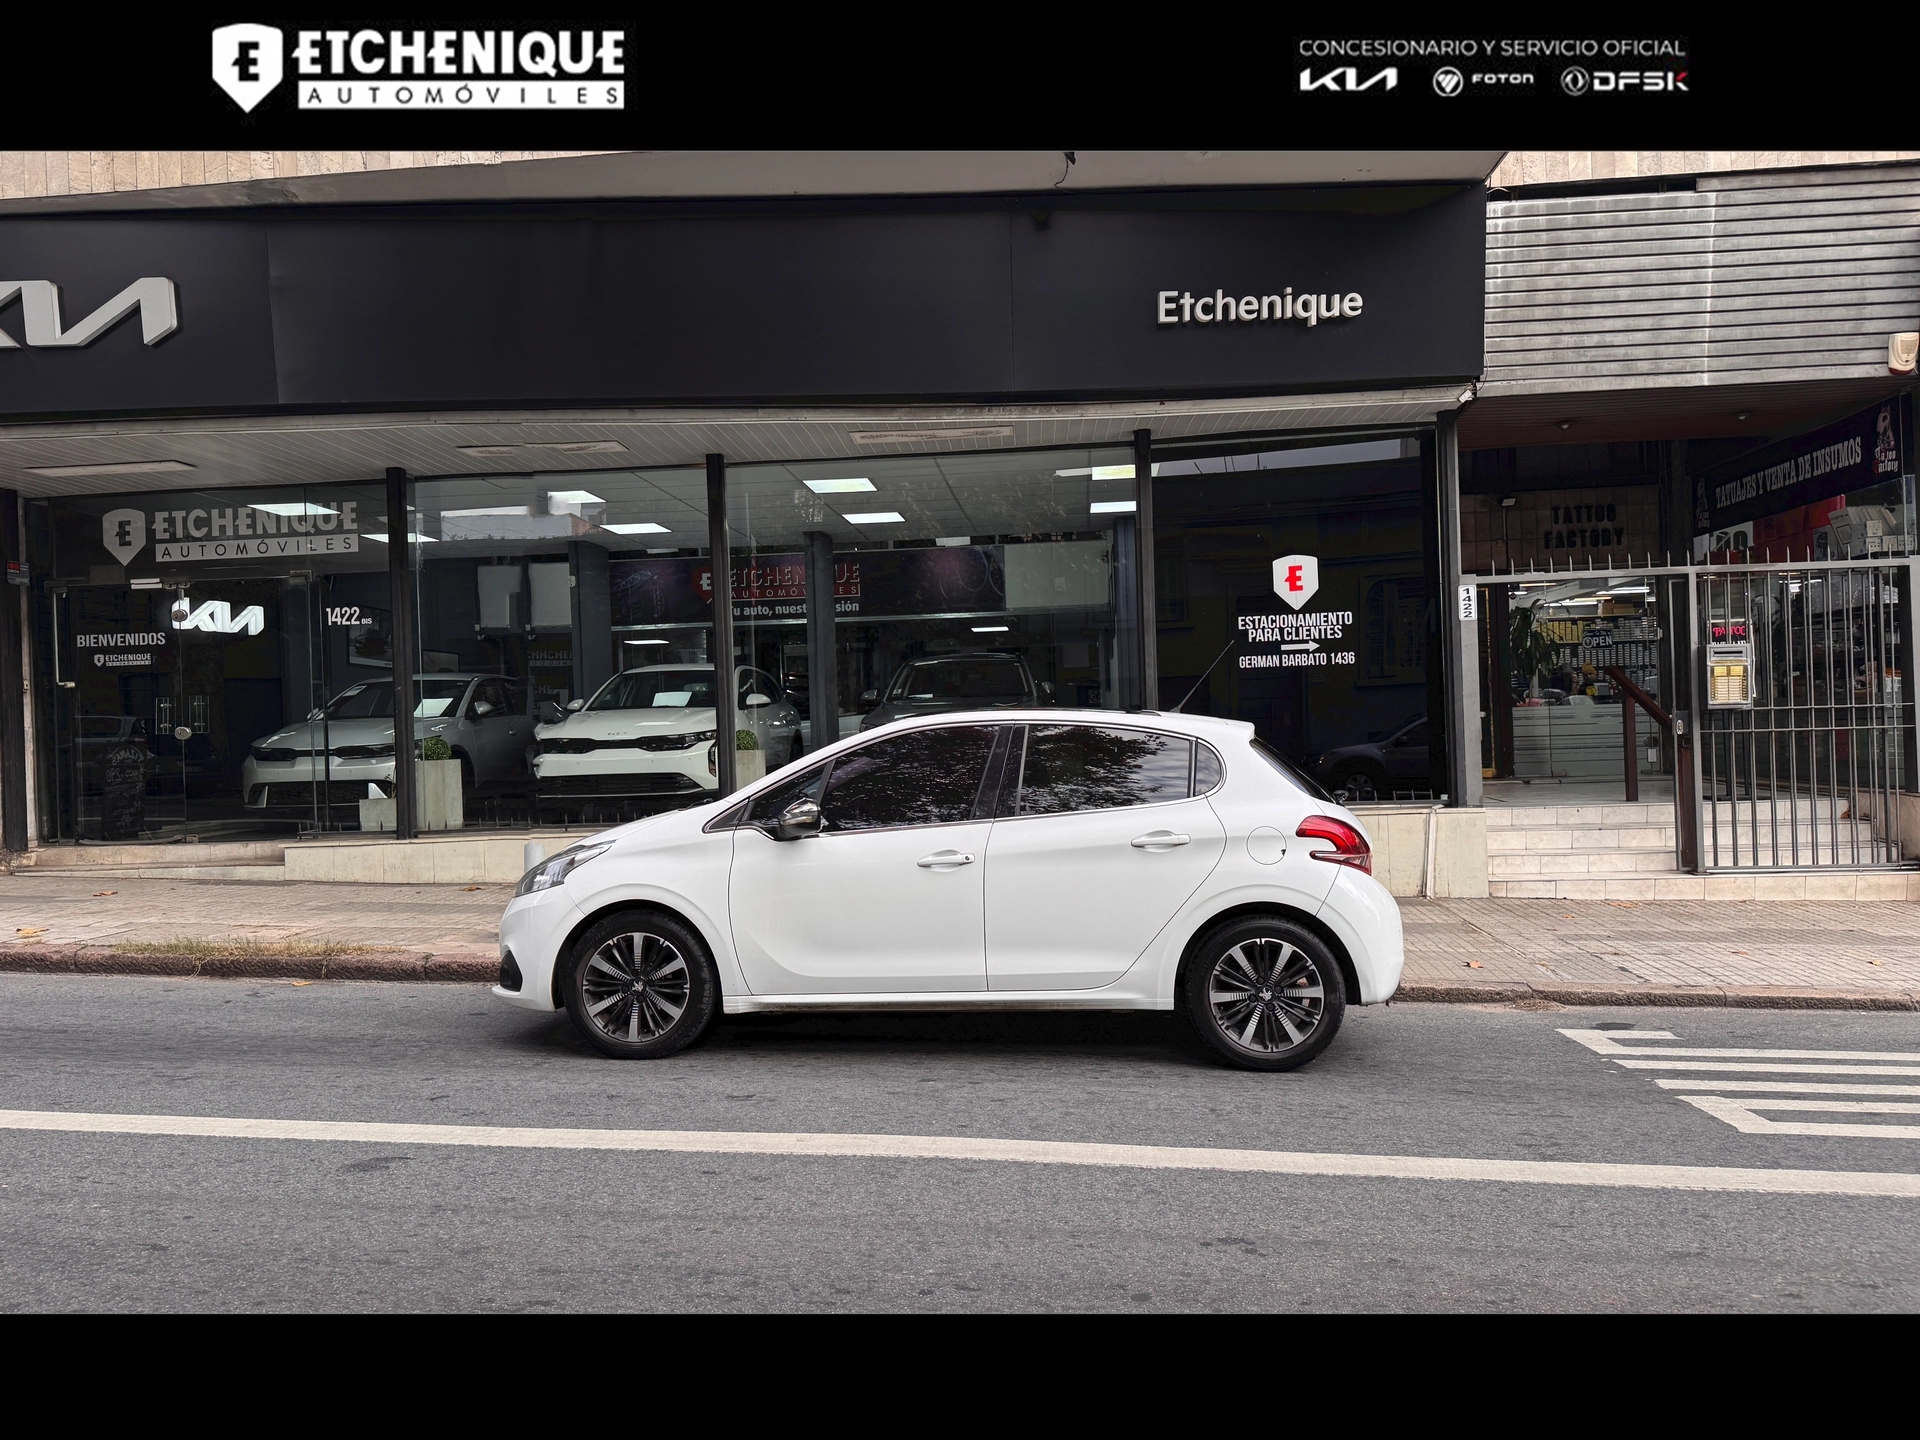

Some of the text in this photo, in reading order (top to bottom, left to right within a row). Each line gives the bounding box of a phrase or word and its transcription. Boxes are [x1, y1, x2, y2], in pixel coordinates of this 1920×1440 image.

[1157, 286, 1363, 327] Etchenique
[1715, 436, 1862, 509] TATUAJES Y VENTA DE INSUMOS
[151, 501, 358, 540] ETCHENIQUE
[1551, 503, 1617, 525] TATTOO
[161, 538, 352, 559] AUTOMÓVILES
[1544, 527, 1624, 550] FACTORY
[730, 563, 860, 587] ETCHENUE
[743, 605, 773, 617] auto,
[775, 602, 807, 614] nuest
[835, 600, 860, 612] sión
[1462, 587, 1473, 618] 1422
[171, 597, 265, 636] KIA
[326, 606, 373, 626] 1422 BIS
[1238, 611, 1353, 630] ESTACIONAMIENTO
[76, 632, 166, 647] BIENVENIDOS
[1248, 625, 1343, 642] PARA CLIENTES
[1712, 625, 1746, 637] TATOO
[1583, 635, 1613, 648] OPEN
[105, 653, 152, 662] ETCHENIQUE
[1239, 652, 1355, 669] GERMAN BARBATO 1436
